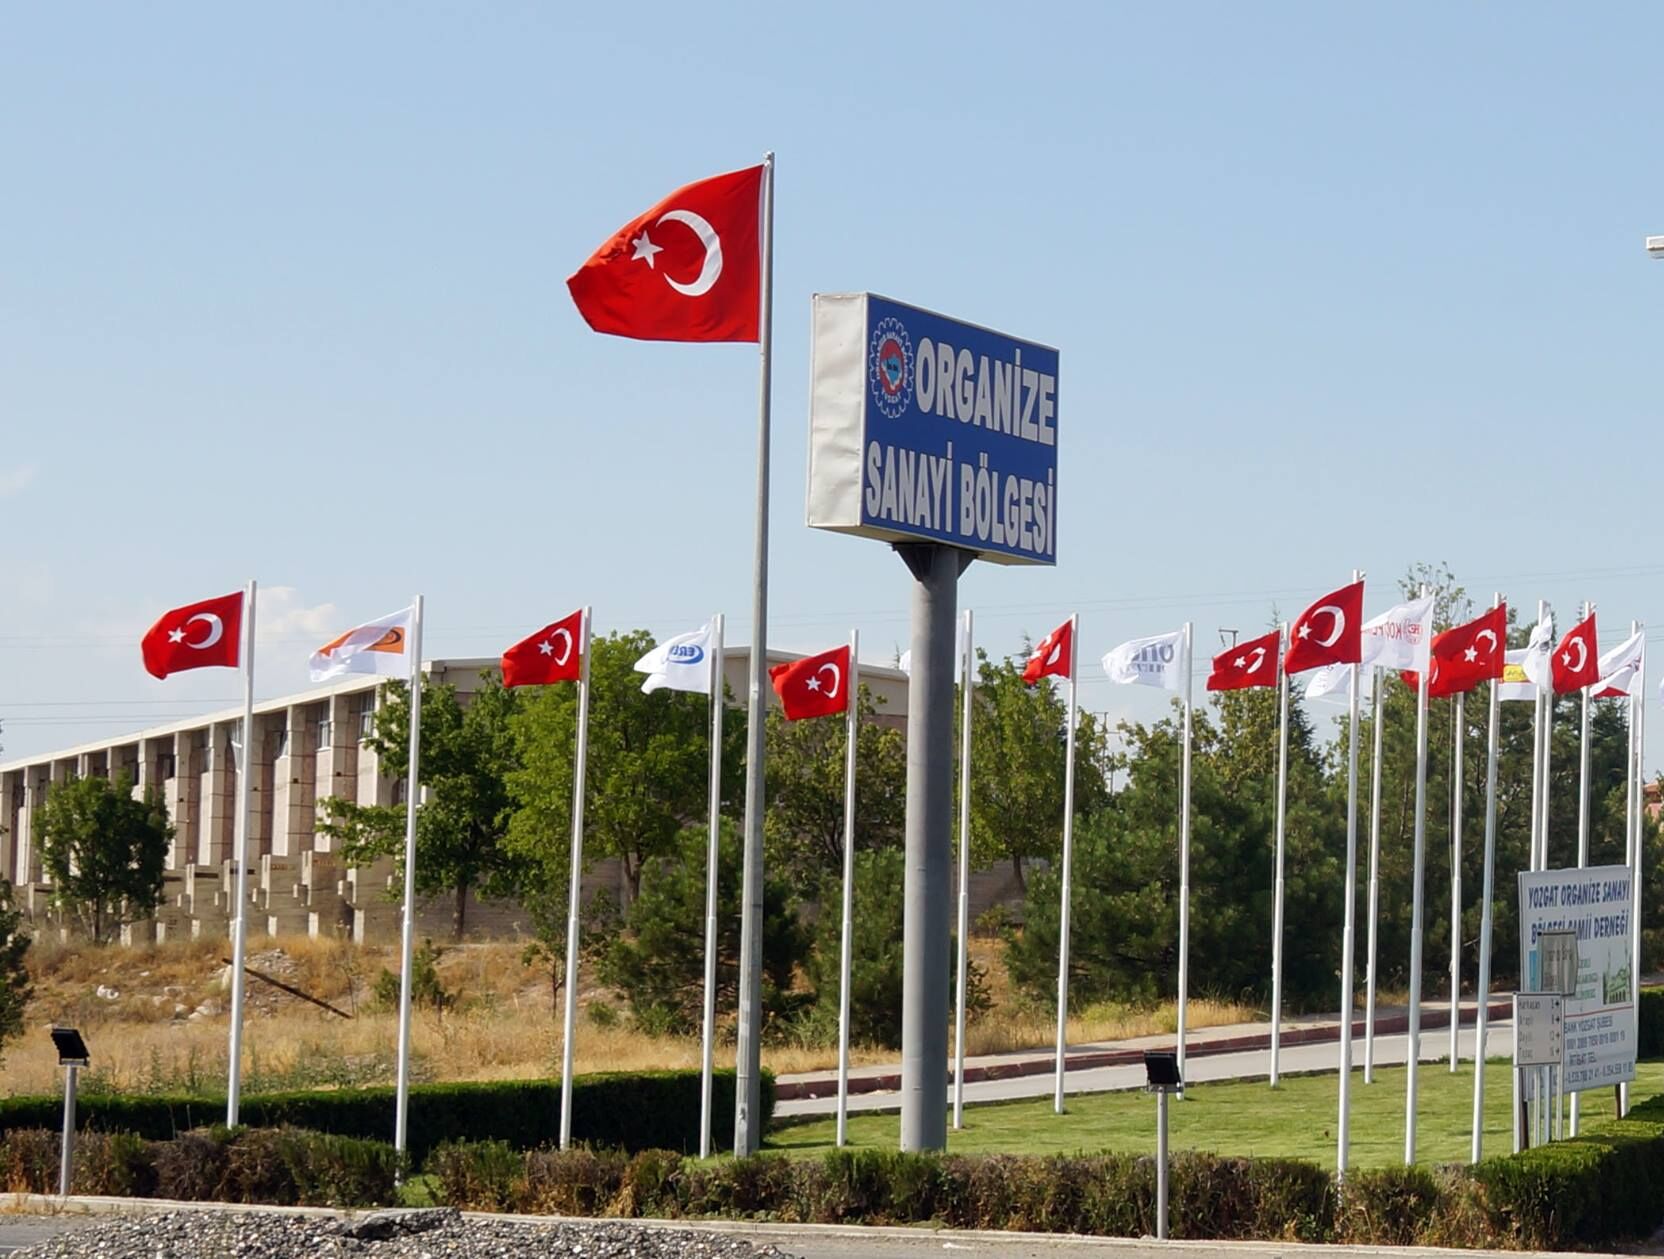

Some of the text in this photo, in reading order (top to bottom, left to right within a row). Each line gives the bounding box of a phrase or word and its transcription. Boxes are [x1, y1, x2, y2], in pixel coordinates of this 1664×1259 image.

[915, 337, 1055, 446] ORGANİZE
[866, 441, 1054, 555] SANAYİ BÖLGESİ
[1528, 874, 1631, 909] YOZGAT ORGANİZE SANAYİ
[1594, 908, 1629, 938] DERNEĞİ
